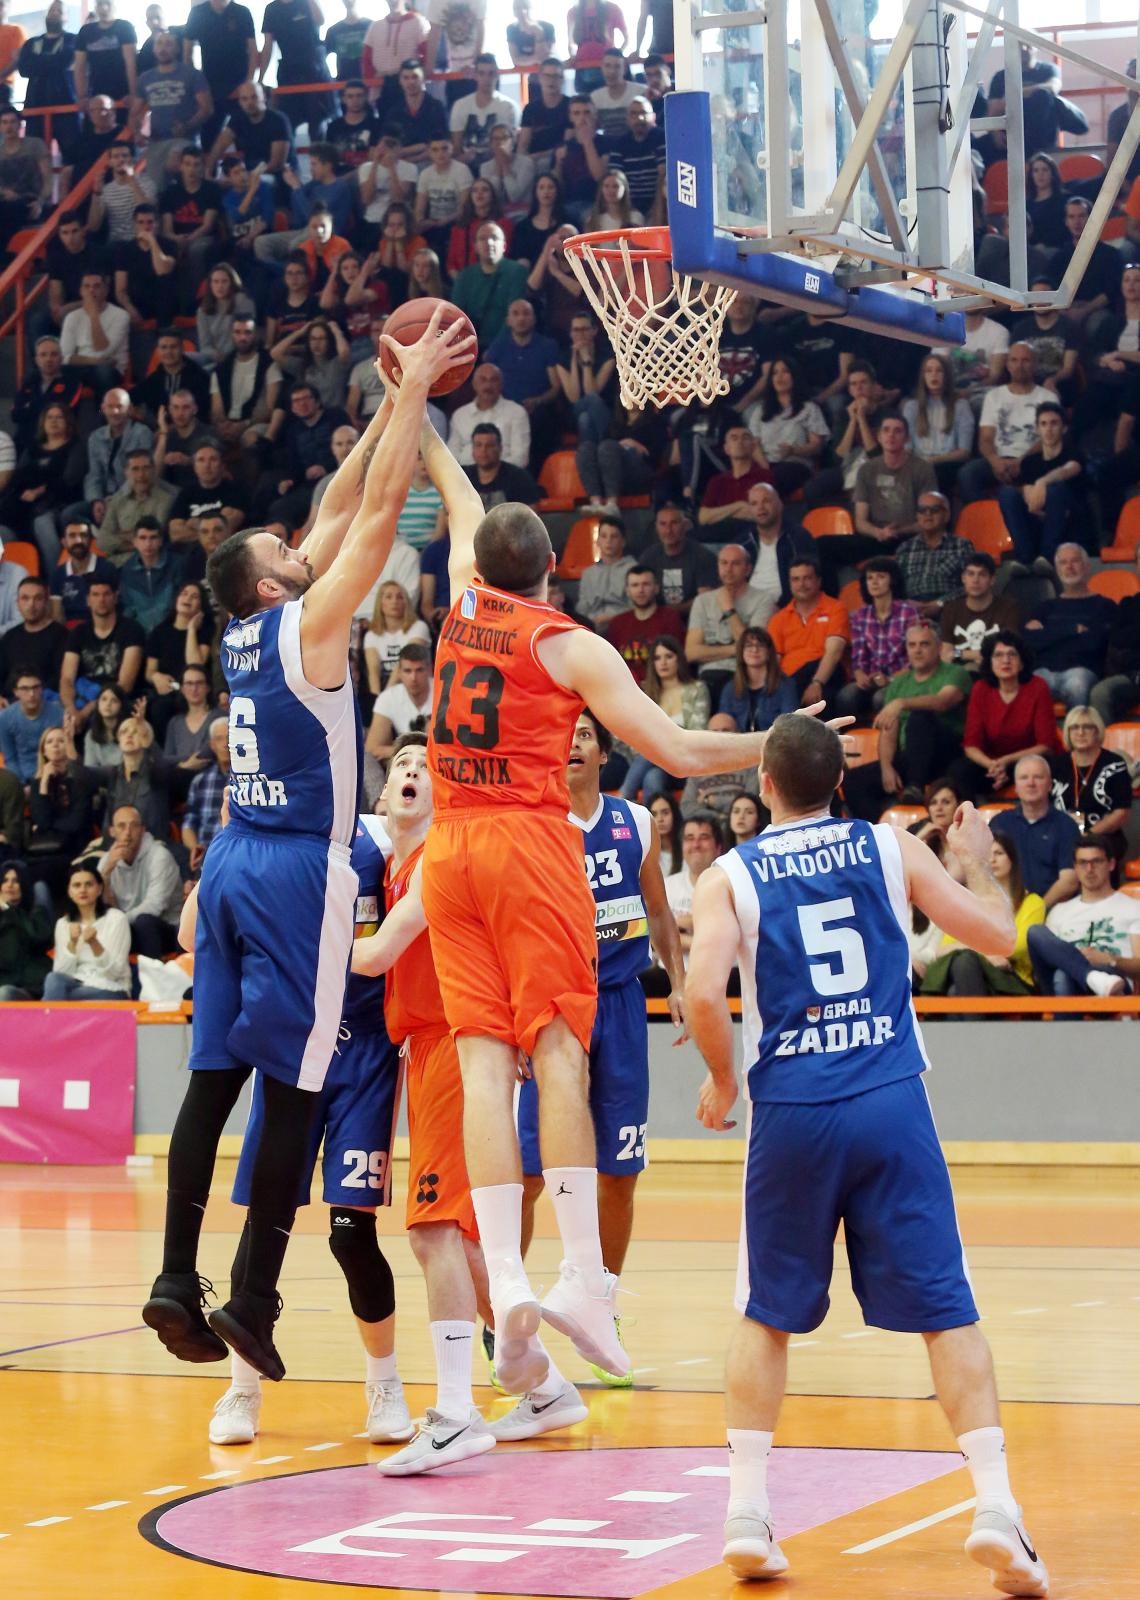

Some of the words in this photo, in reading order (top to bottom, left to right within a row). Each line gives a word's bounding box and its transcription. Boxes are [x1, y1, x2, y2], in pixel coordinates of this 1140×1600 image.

[677, 160, 697, 208] ELAN
[804, 272, 820, 294] ELAN
[483, 598, 515, 614] KRKA
[433, 660, 505, 751] 13
[228, 696, 260, 774] 6
[752, 835, 873, 883] VLADOVIĆ
[797, 896, 869, 997] 5
[823, 998, 872, 1020] GRAD
[775, 1015, 896, 1056] ZADAR
[341, 1149, 388, 1189] 29
